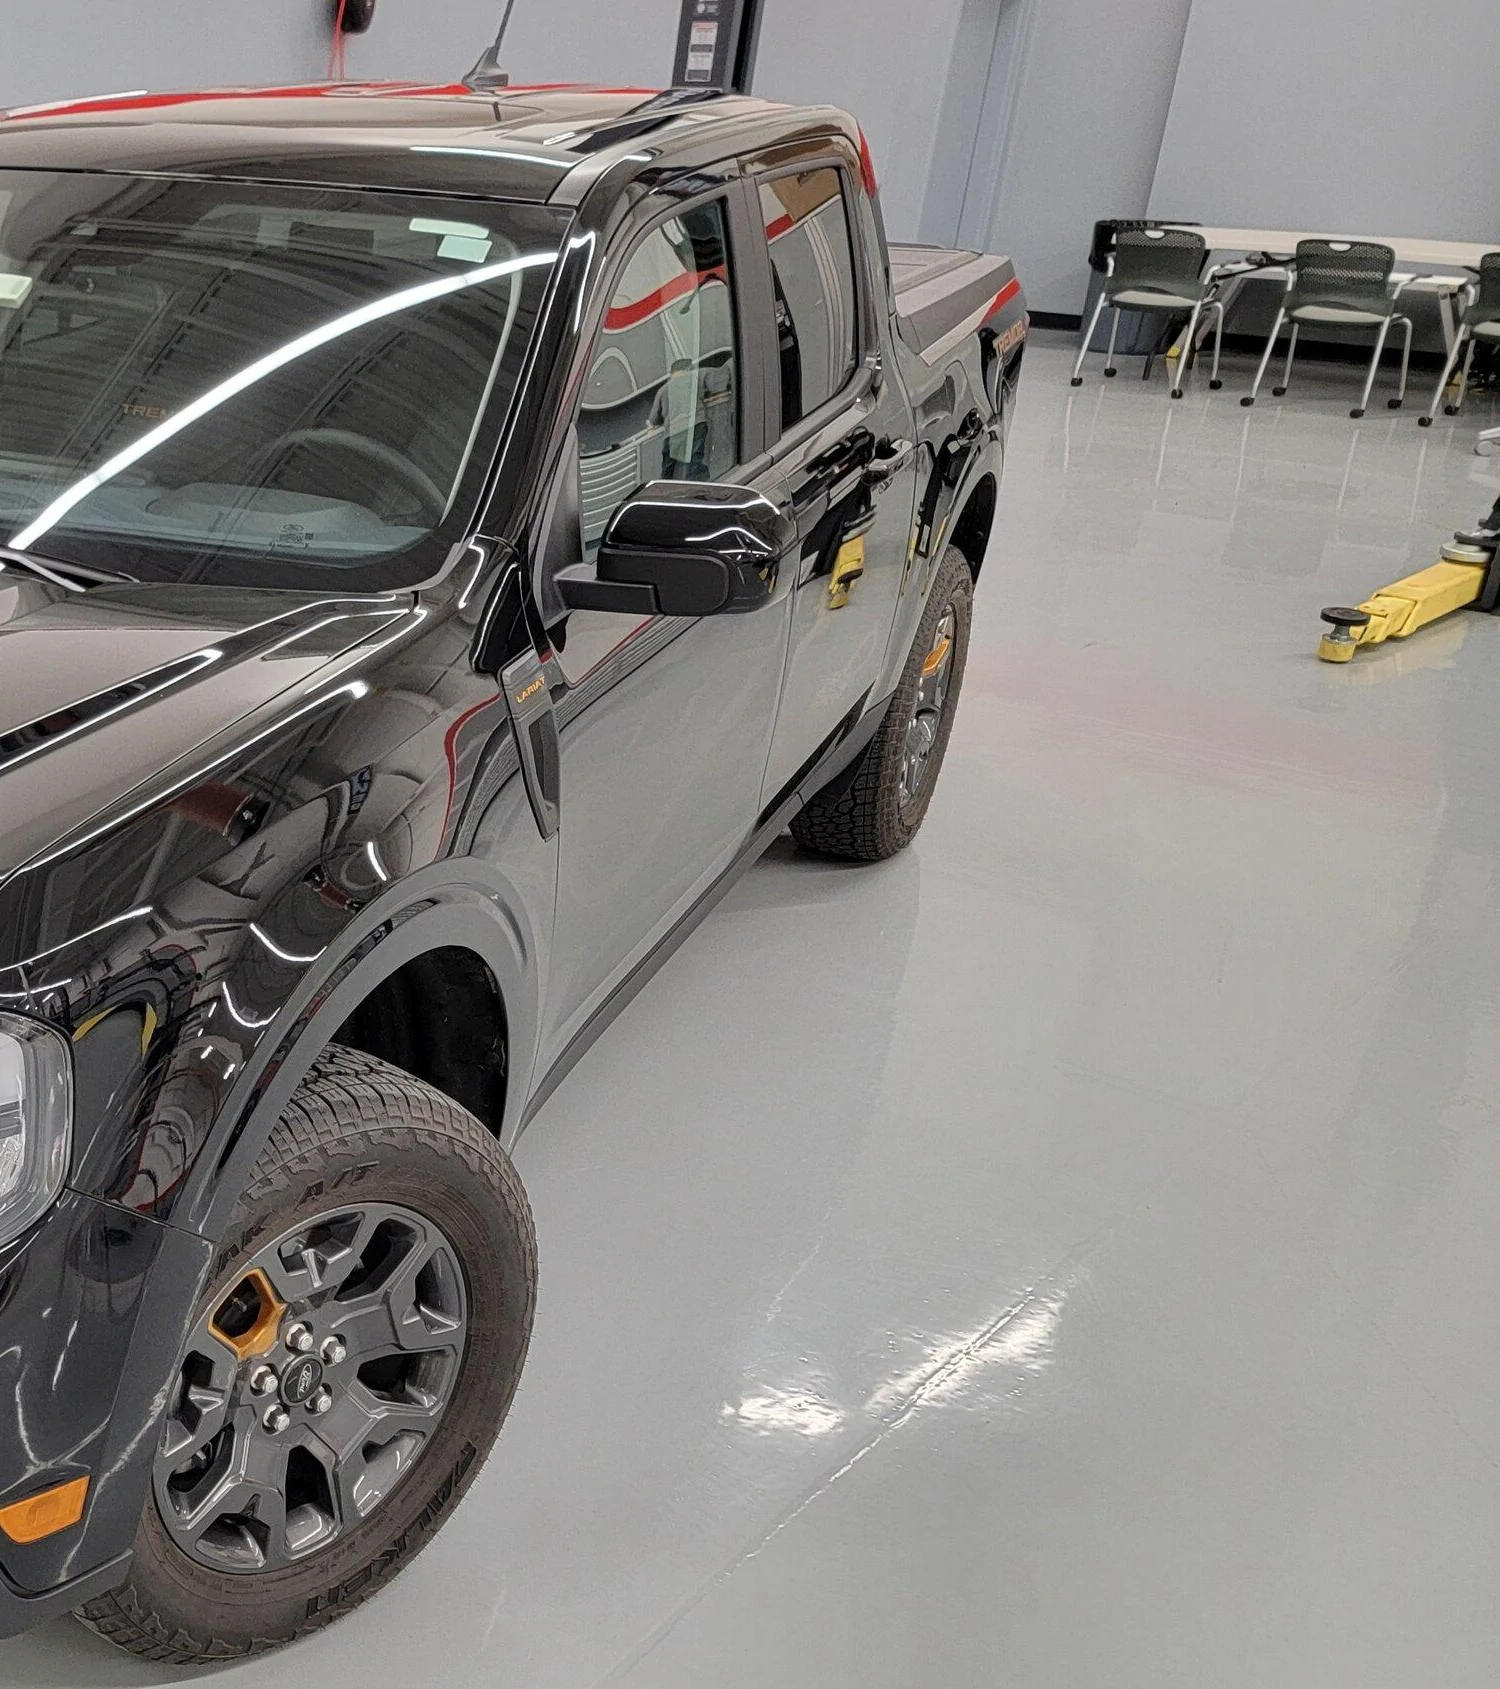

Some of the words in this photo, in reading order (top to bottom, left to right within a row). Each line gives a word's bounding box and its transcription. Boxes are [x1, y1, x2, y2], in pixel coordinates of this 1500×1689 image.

[516, 675, 545, 703] LARIAT
[299, 1368, 311, 1393] Ford
[306, 1441, 476, 1618] FALKEN
